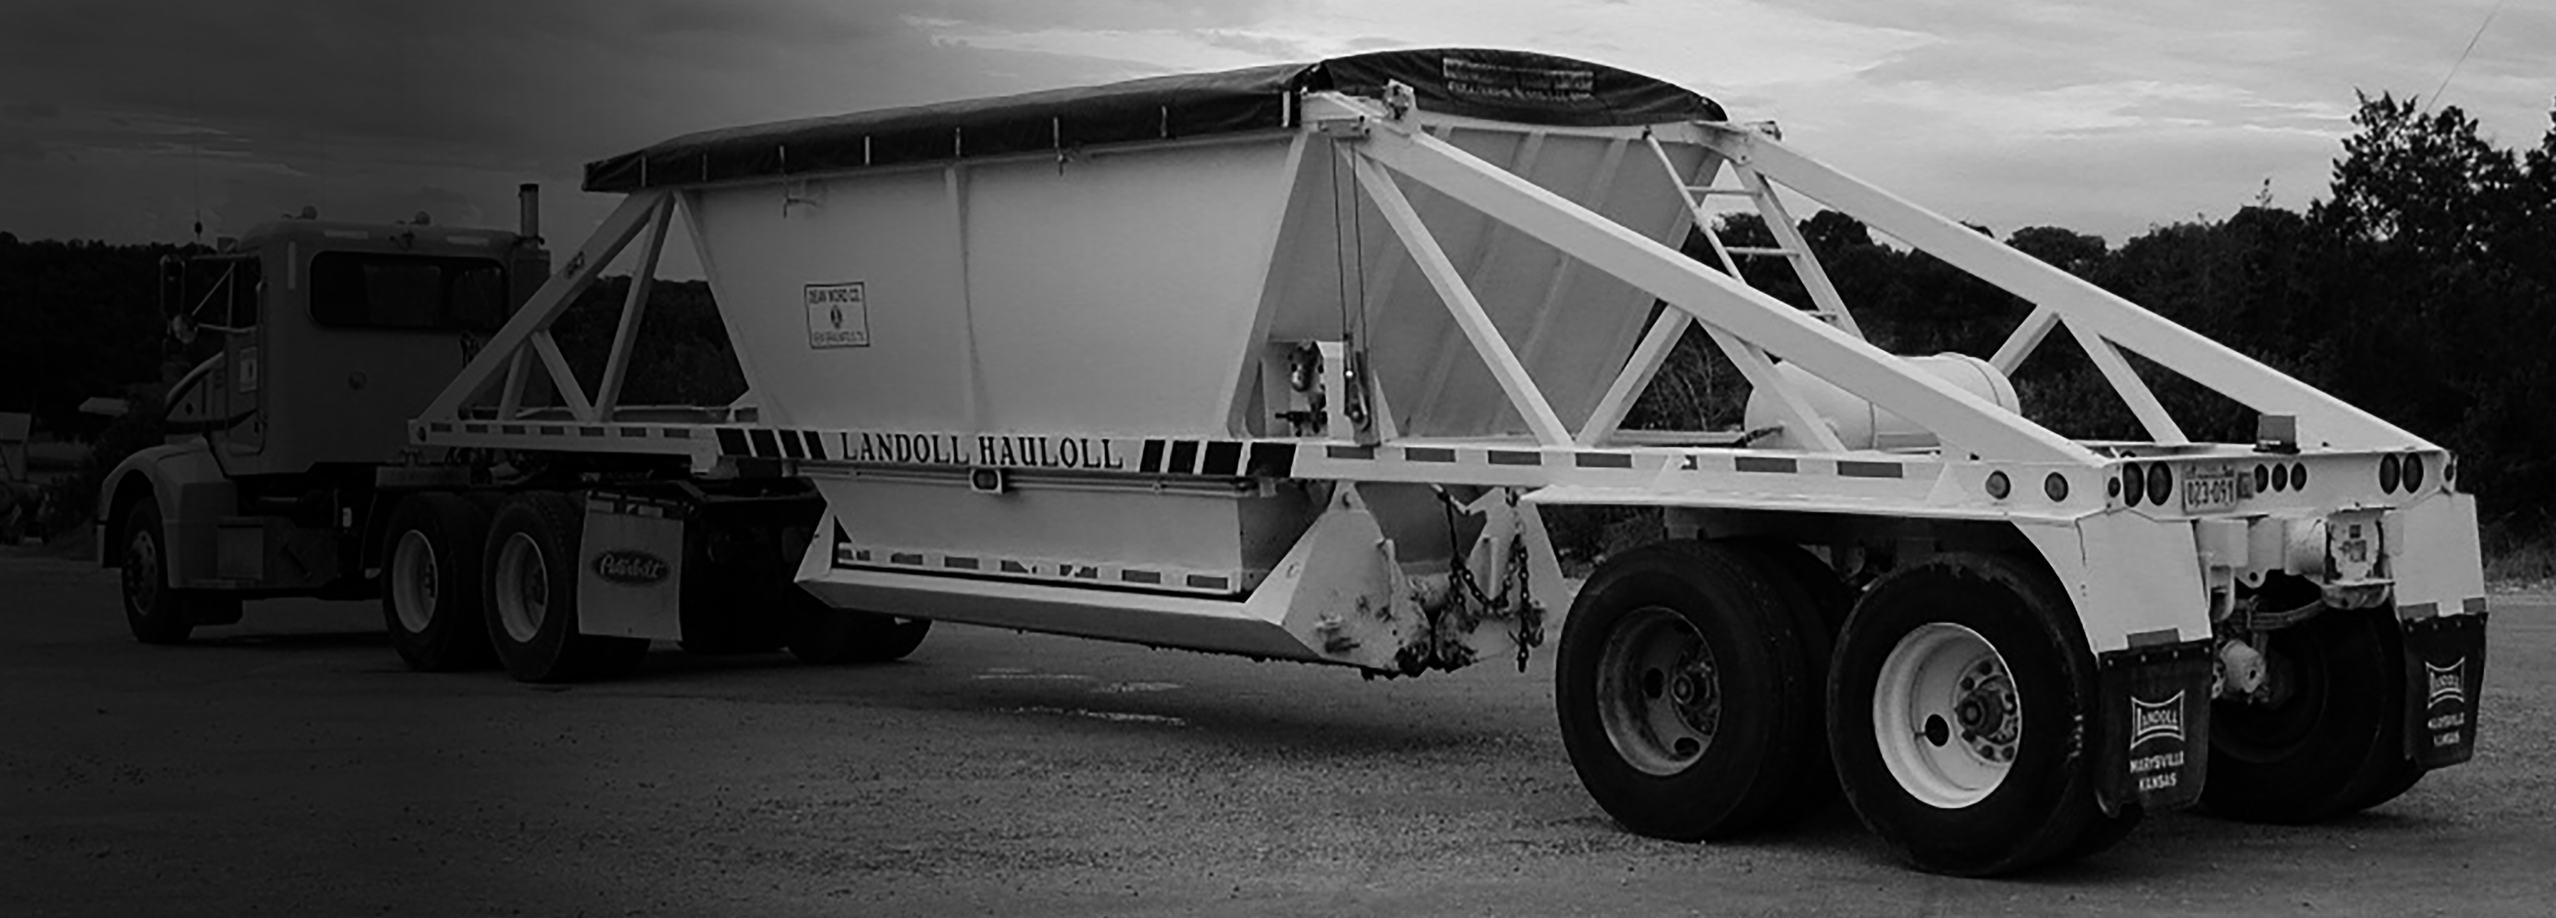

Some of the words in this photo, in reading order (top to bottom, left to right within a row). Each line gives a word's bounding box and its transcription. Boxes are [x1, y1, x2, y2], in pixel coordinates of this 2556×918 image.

[839, 432, 969, 465] LANDOLL
[978, 435, 1123, 469] HAULOLL
[2137, 707, 2179, 736] LANDOLL
[2130, 751, 2184, 774] MARYSVILLE
[2139, 772, 2177, 792] KANSAS
